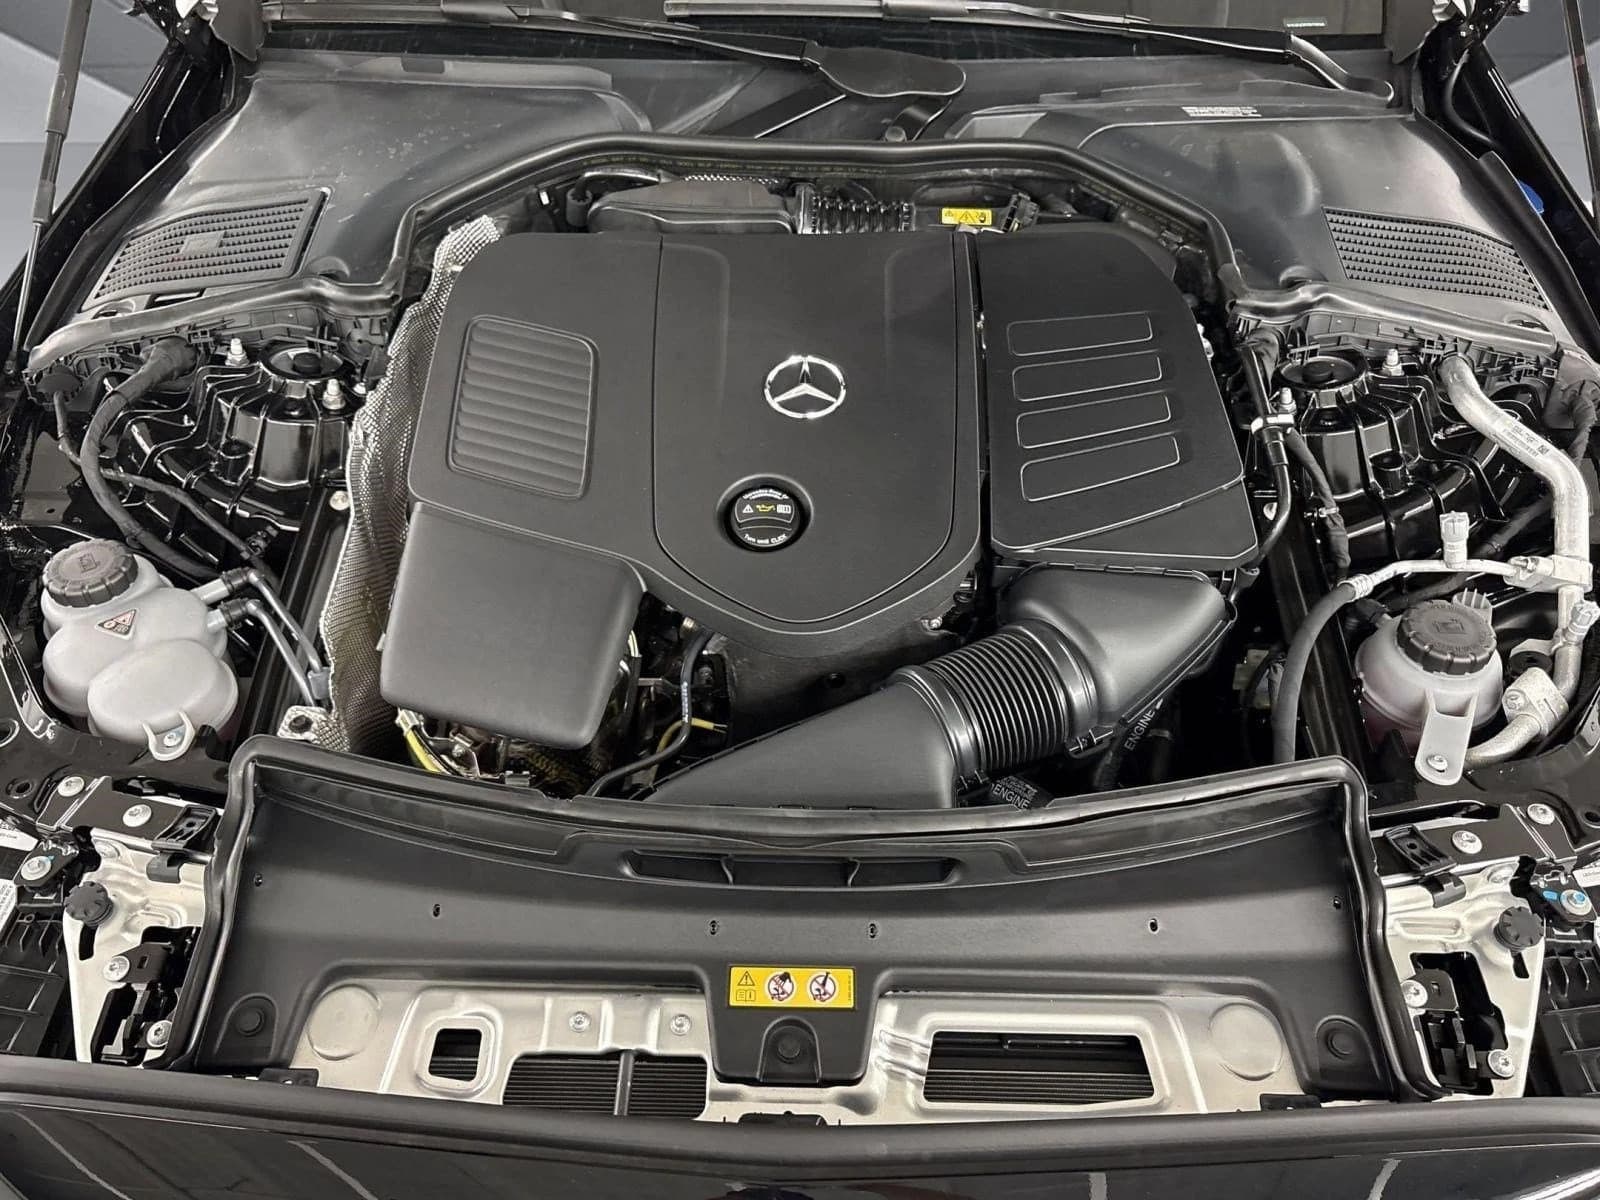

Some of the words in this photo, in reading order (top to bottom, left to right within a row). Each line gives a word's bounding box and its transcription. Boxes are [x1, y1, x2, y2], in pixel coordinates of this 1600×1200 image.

[770, 533, 788, 543] CLICK
[1124, 709, 1156, 751] ENGINE
[993, 783, 1031, 810] ENGINE
